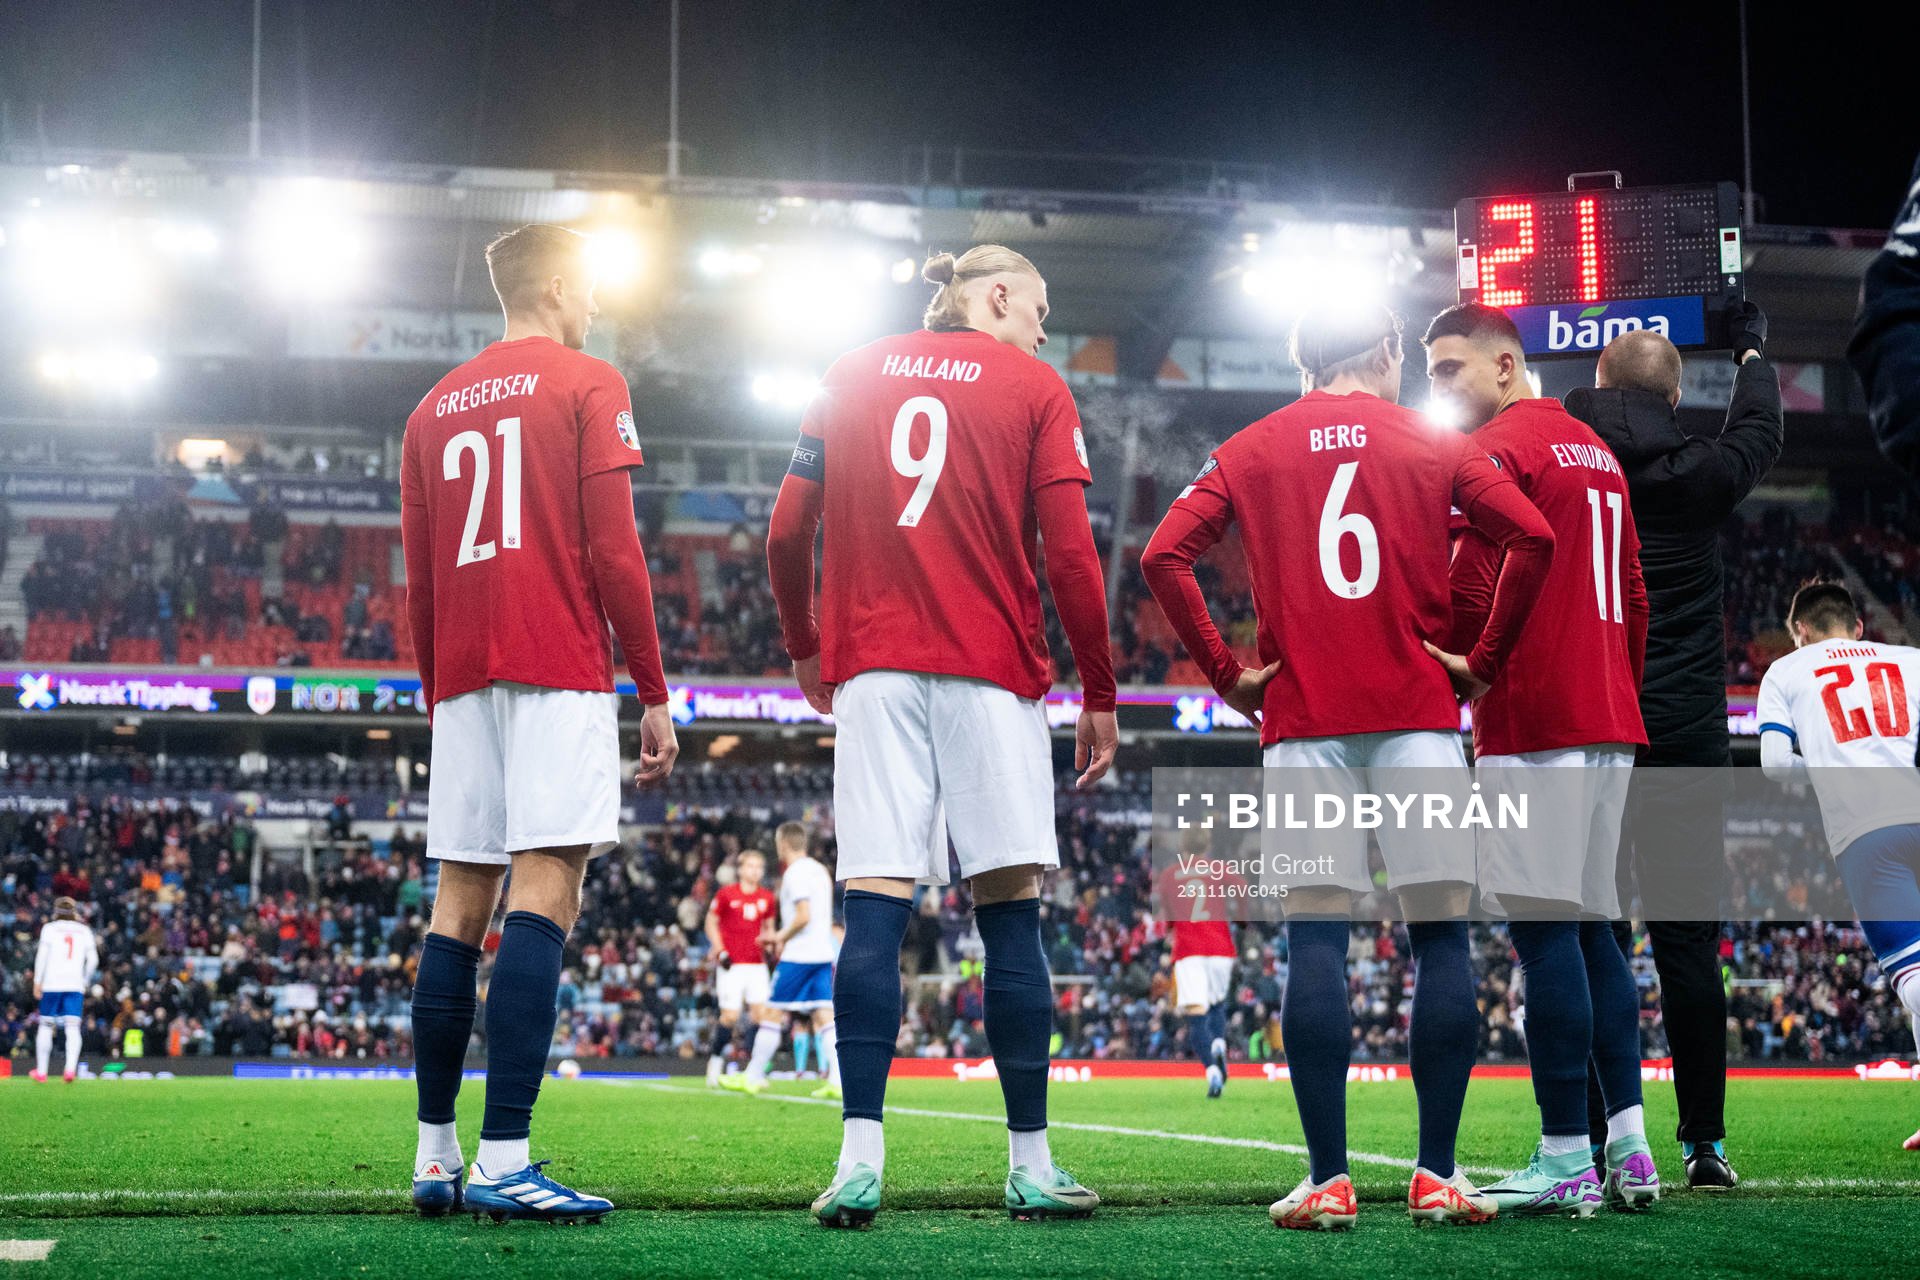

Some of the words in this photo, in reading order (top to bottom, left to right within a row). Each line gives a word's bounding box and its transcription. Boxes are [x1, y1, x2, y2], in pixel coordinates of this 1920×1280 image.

[1480, 199, 1599, 306] 21
[436, 374, 539, 417] GREGERSEN
[882, 354, 982, 383] HAALAND
[890, 396, 948, 527] 9
[1309, 424, 1367, 452] BERG
[443, 417, 522, 568] 21
[1319, 461, 1381, 599] 6
[1587, 487, 1622, 624] 11
[59, 680, 126, 705] Norsk
[126, 680, 212, 712] Tipping
[1814, 662, 1911, 744] 20
